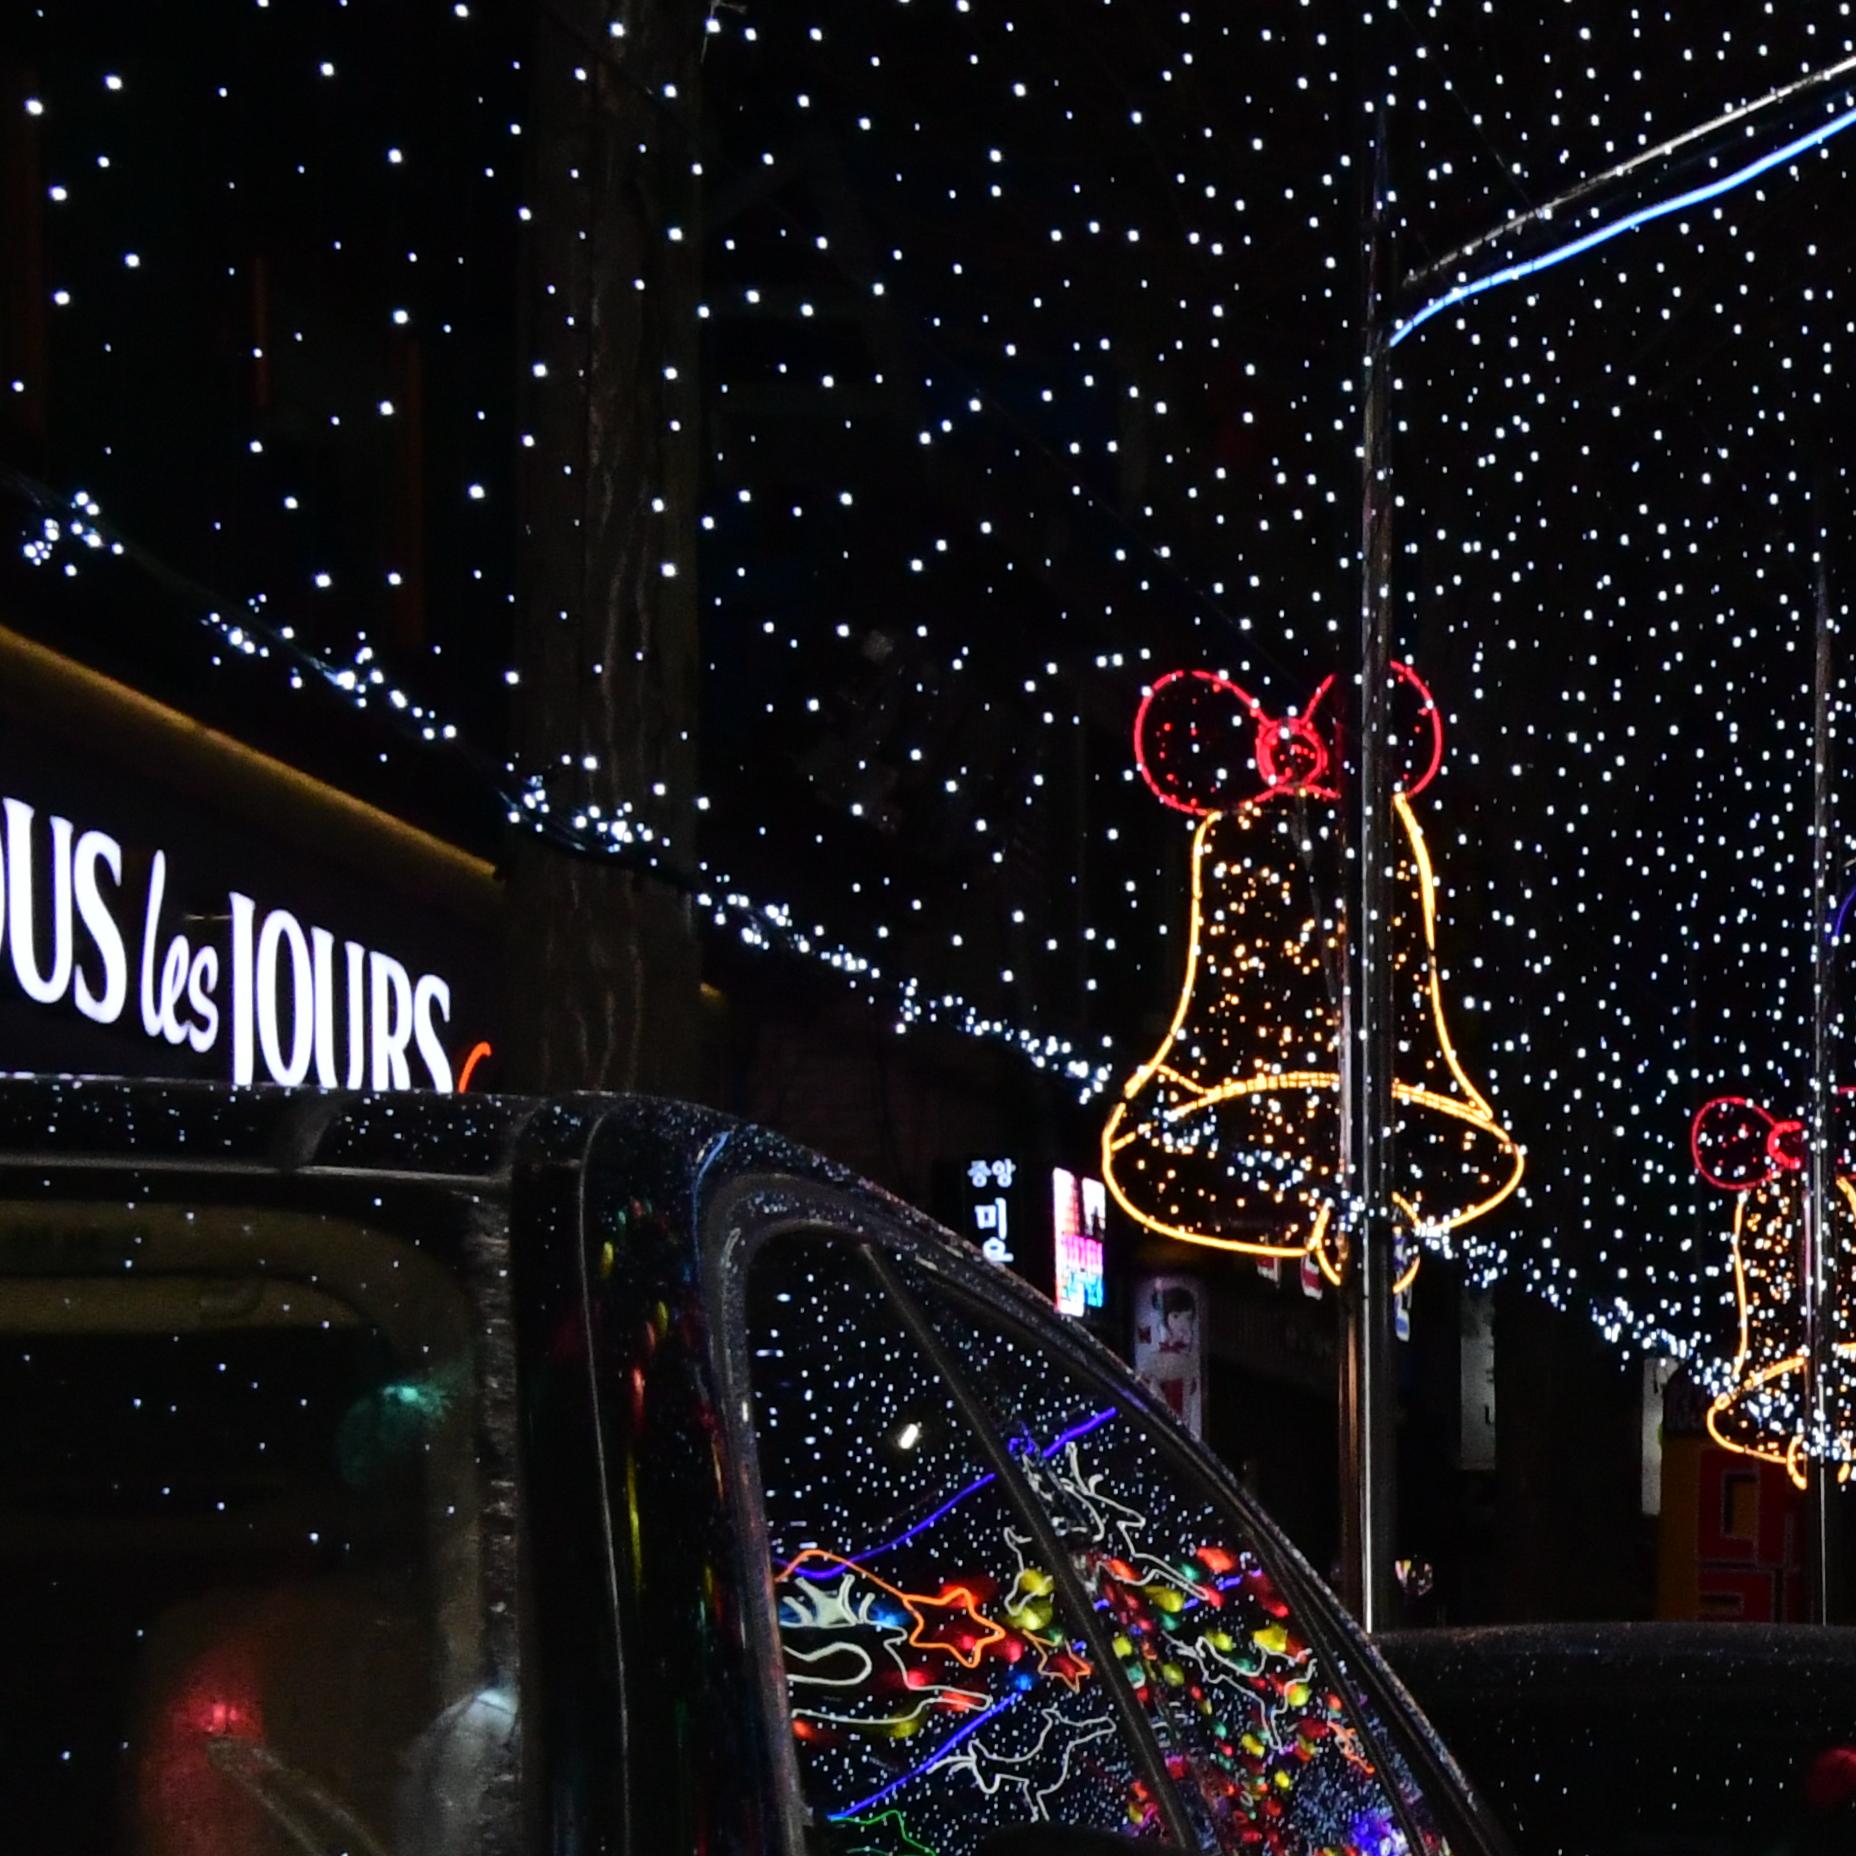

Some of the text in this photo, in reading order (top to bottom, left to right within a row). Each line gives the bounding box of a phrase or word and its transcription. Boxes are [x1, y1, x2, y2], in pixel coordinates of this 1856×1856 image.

[0, 797, 128, 1025] US
[140, 849, 219, 1053] les
[967, 1158, 1016, 1188] 중앙
